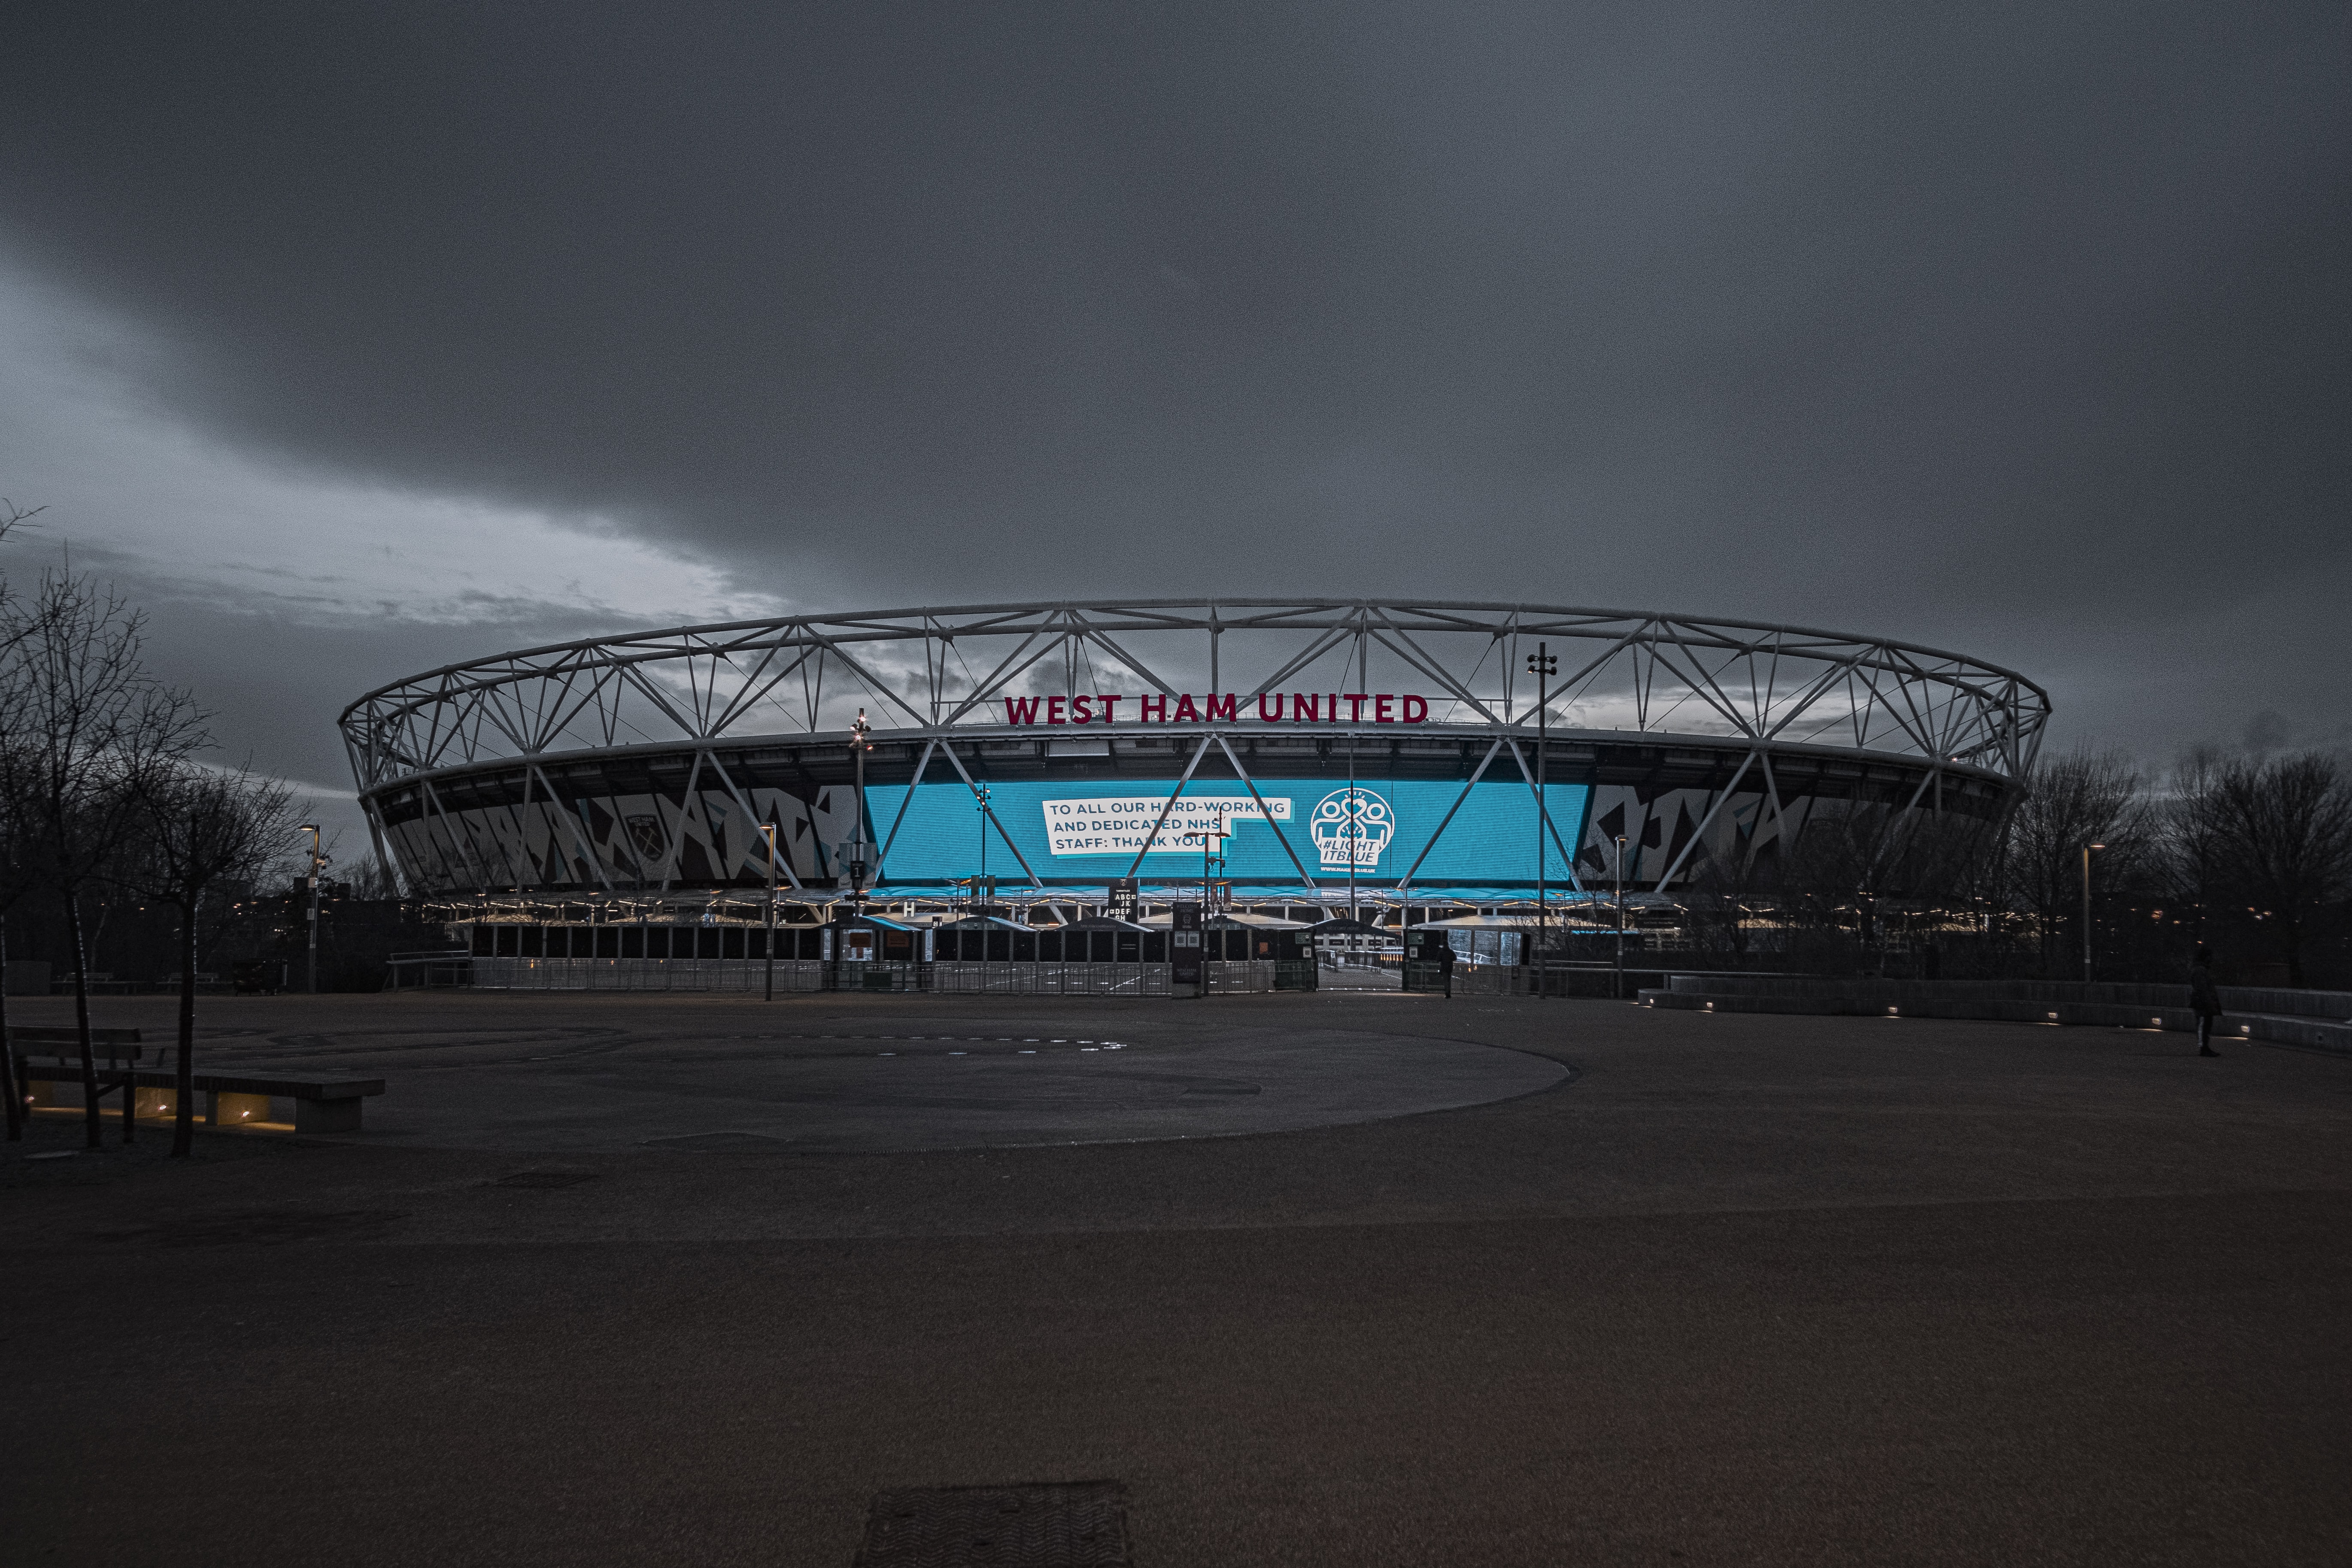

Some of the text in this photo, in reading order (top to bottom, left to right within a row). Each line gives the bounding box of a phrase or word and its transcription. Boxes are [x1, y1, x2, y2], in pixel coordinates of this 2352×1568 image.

[1005, 693, 1428, 725] WEST HAM UNITED
[1050, 804, 1071, 815] TO
[1077, 804, 1106, 814] ALL
[1111, 802, 1145, 813] OUR
[1054, 819, 1220, 832] AND DEDICATED NHS
[1056, 838, 1108, 849] STAFF:
[1172, 836, 1206, 846] YOU
[1323, 840, 1377, 851] #LIGHT
[1323, 850, 1375, 862] ITBLUE
[854, 867, 860, 877] 1
[903, 901, 915, 917] H
